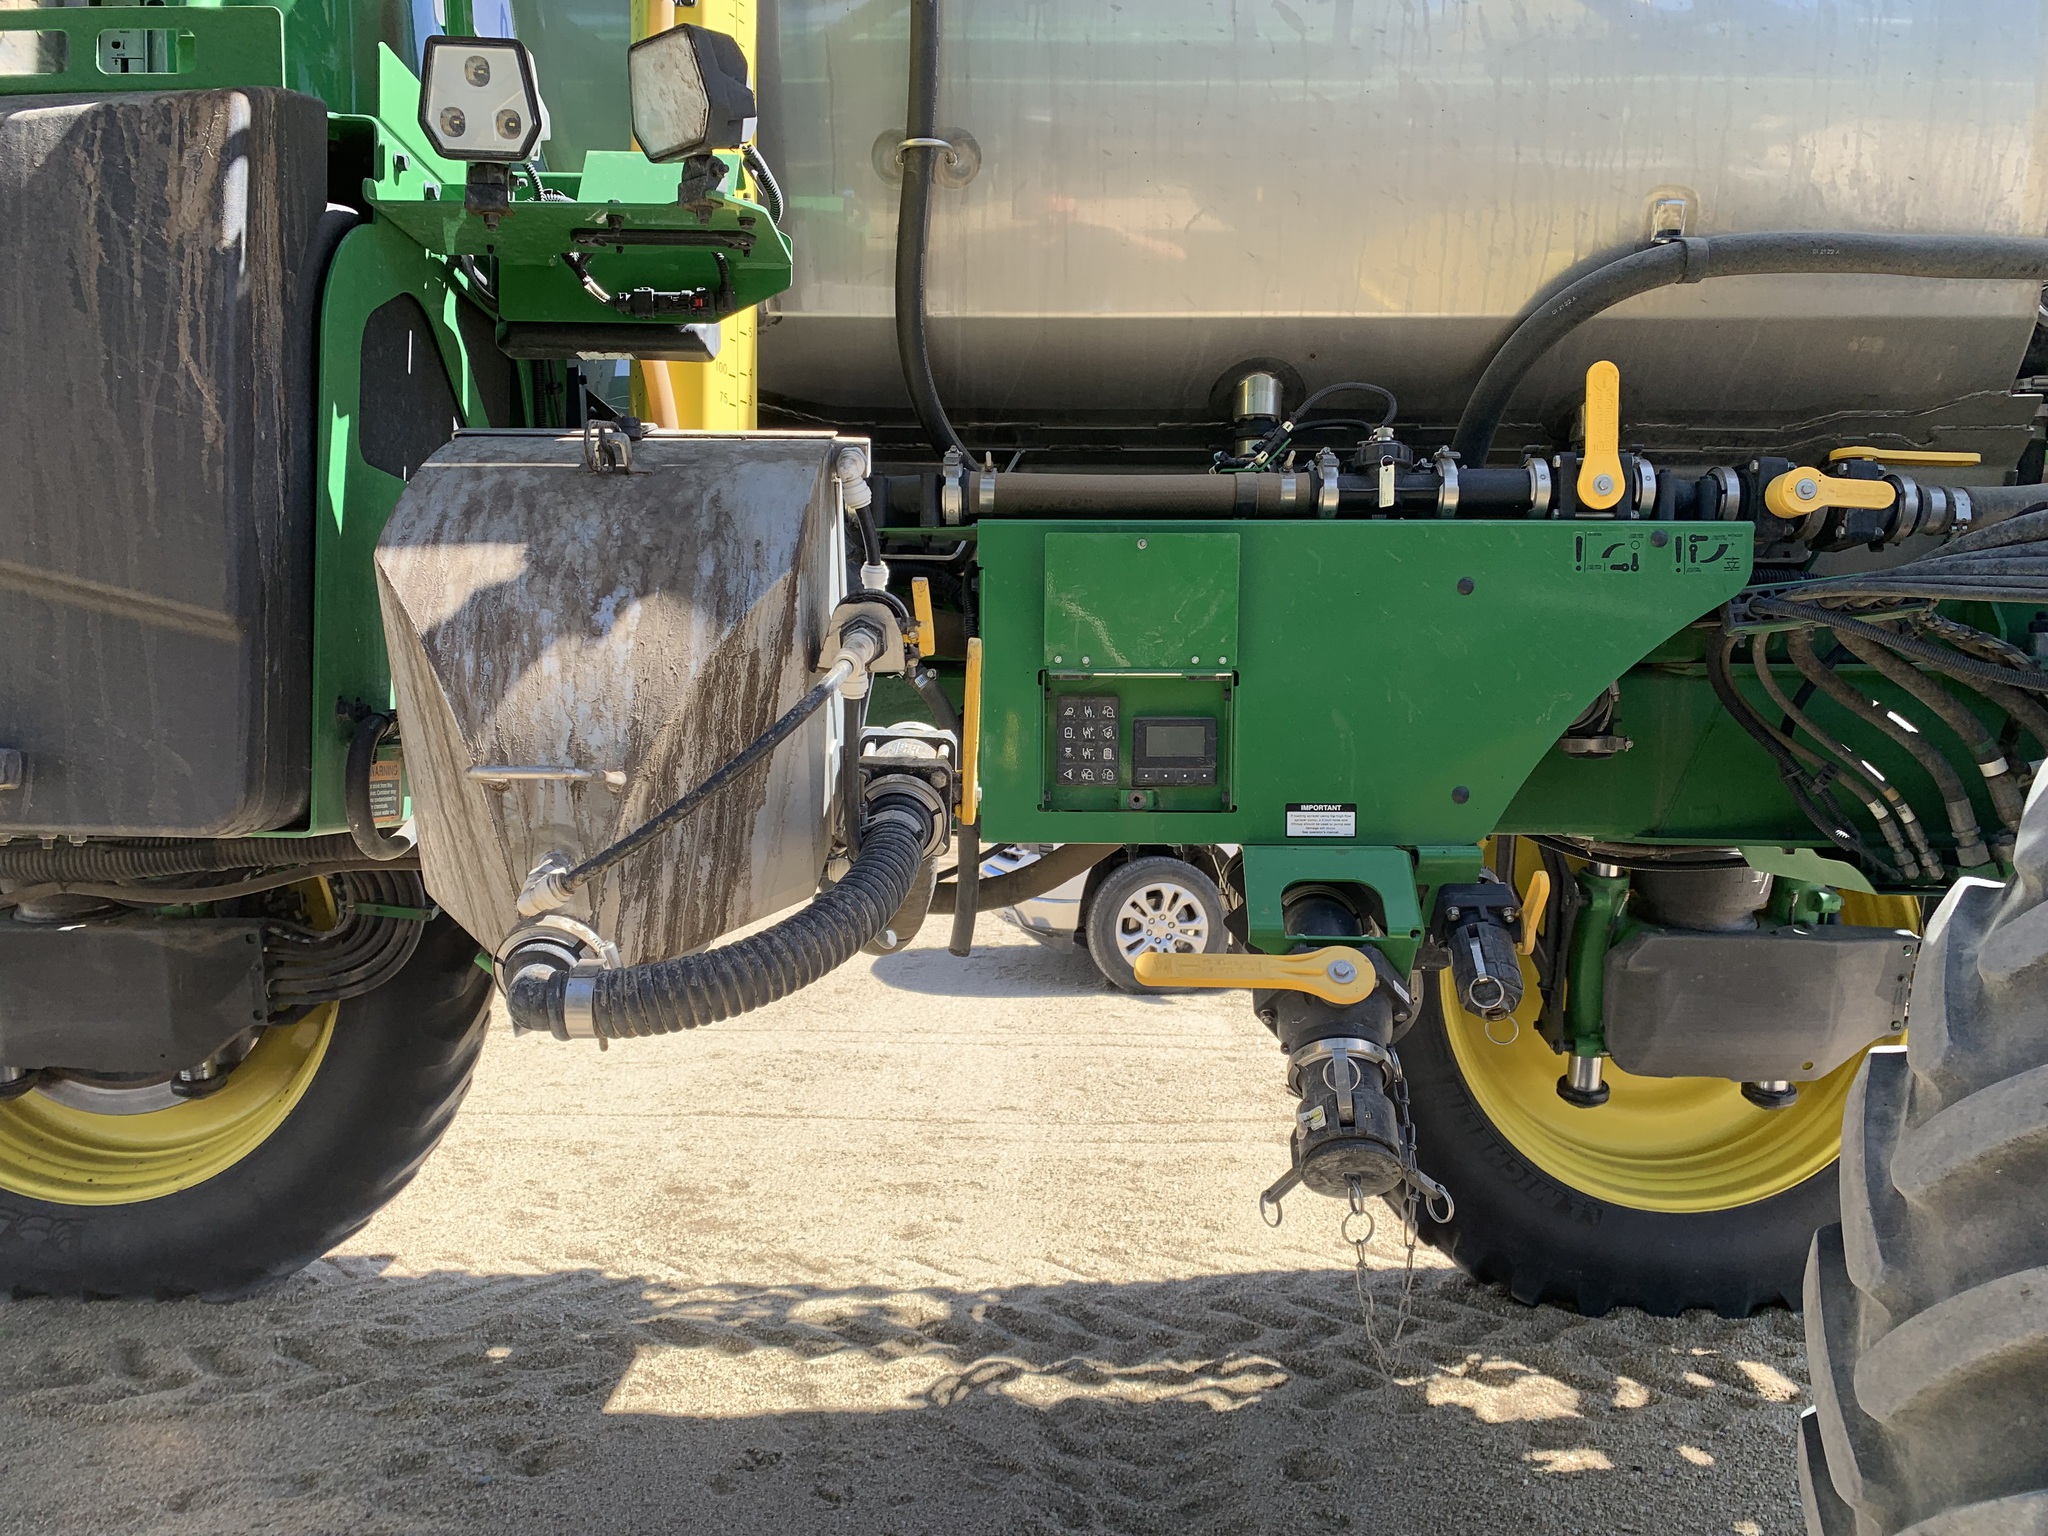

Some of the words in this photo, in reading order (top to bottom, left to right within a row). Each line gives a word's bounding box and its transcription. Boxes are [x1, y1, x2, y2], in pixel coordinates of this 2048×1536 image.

[715, 360, 728, 375] 100
[748, 368, 753, 379] 4
[719, 390, 729, 404] 75
[748, 394, 753, 407] 3
